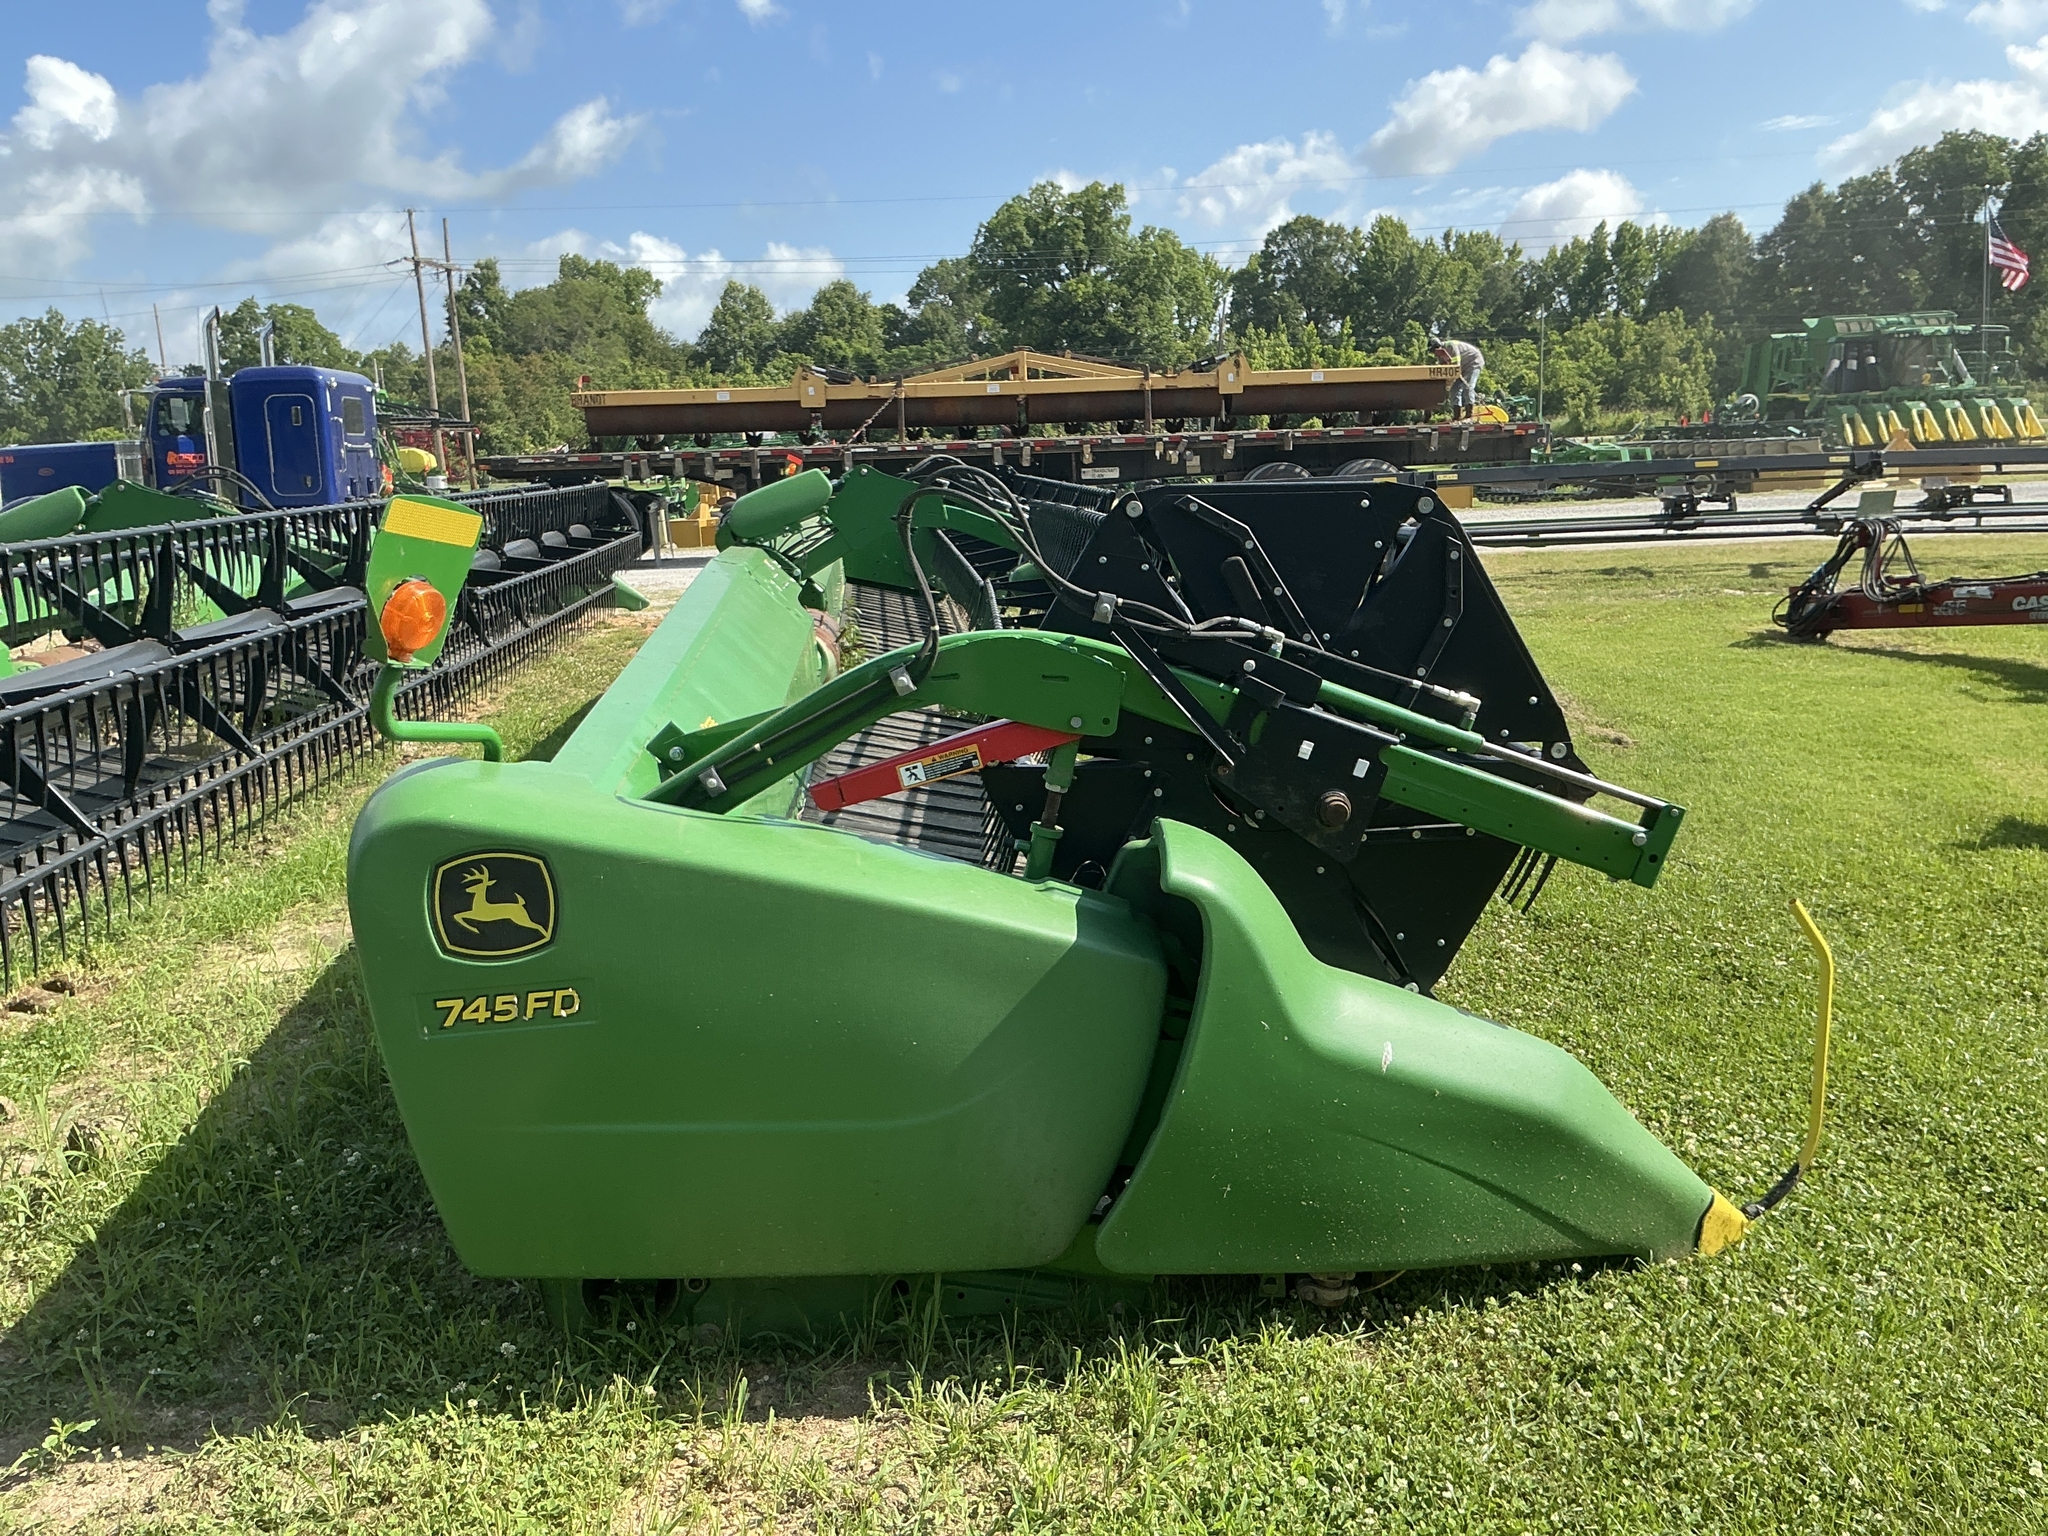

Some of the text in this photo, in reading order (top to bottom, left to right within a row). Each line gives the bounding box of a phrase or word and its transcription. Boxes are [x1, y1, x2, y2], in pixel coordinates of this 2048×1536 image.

[1428, 366, 1460, 377] HR40F
[571, 394, 606, 406] BRANDT
[938, 747, 969, 760] WARNING
[435, 987, 581, 1028] 745FD
